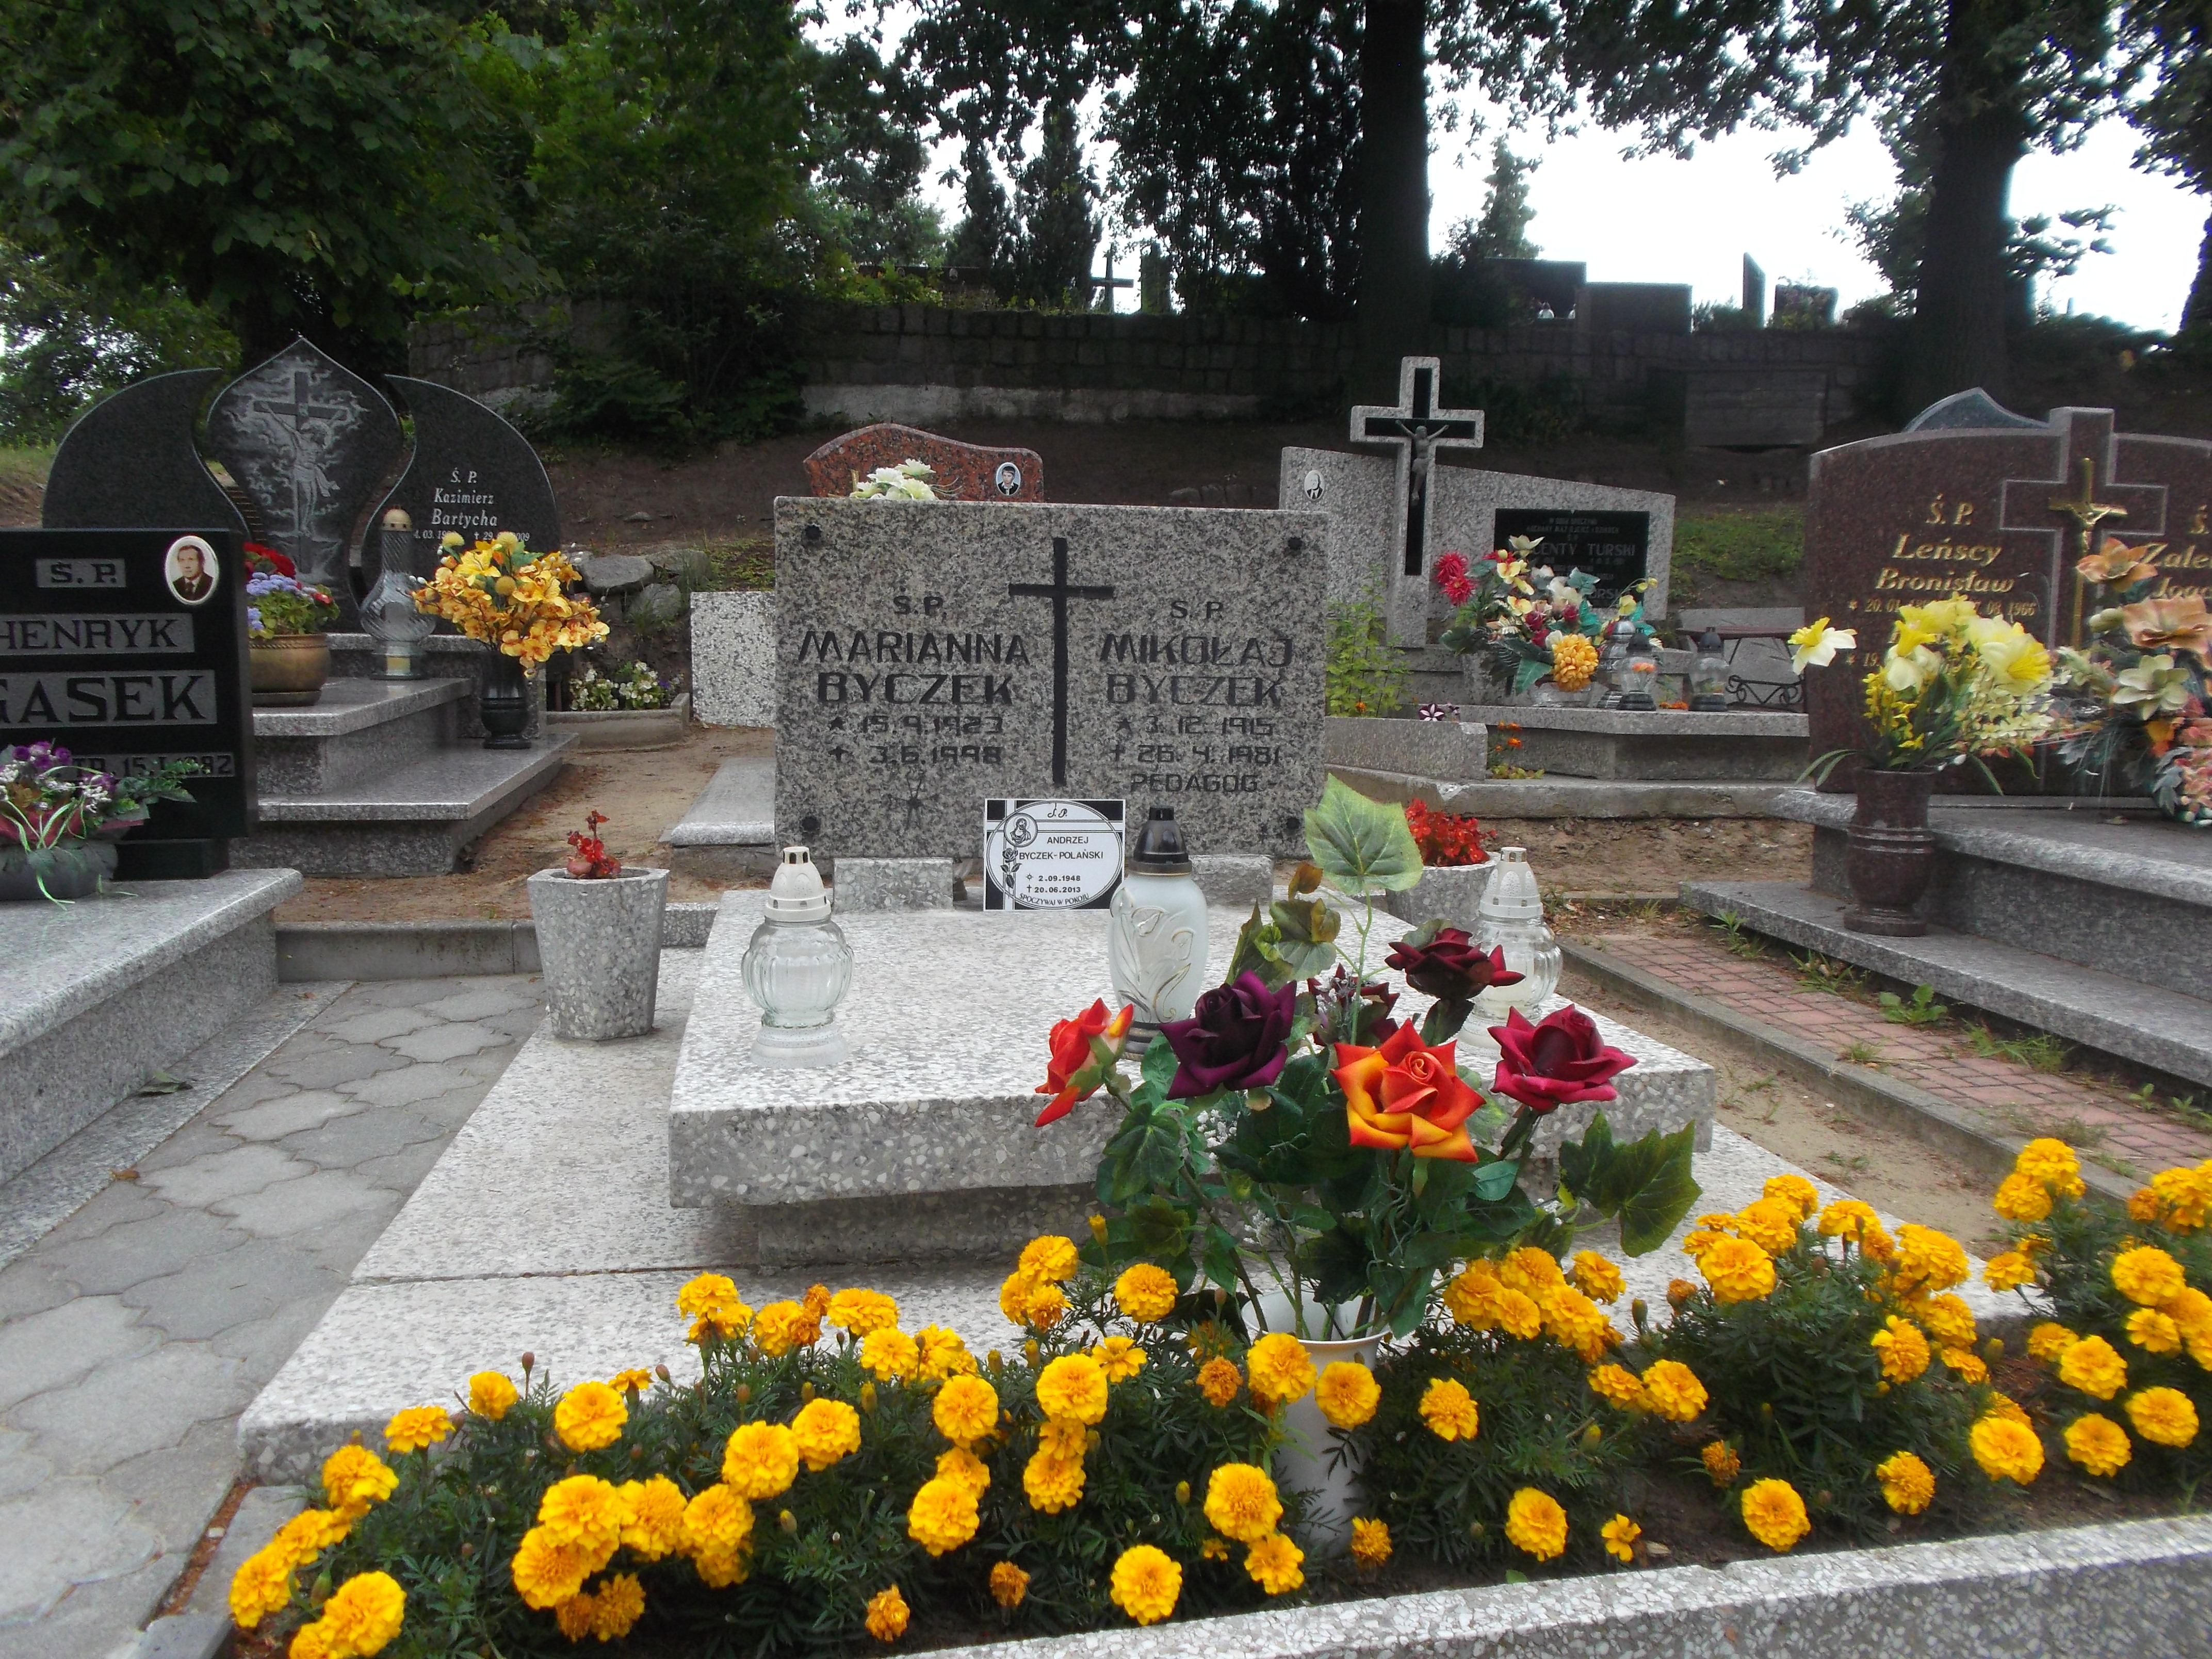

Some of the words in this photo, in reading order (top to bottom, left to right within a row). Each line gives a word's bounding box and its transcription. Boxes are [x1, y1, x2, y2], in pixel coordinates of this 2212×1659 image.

[467, 470, 478, 483] P.
[434, 488, 494, 505] Kazimierz
[431, 508, 498, 529] Bartycha
[1954, 502, 1975, 526] P.
[1892, 533, 2004, 567] Leńscy
[1875, 566, 2016, 593] Bronisław
[798, 630, 1030, 665] MARIANNA
[1099, 633, 1293, 668] MIKOŁAJ
[818, 672, 1013, 706] BYCZEK
[1107, 672, 1282, 707] BYCZEK
[1130, 773, 1260, 792] PEDAGOG
[1047, 836, 1089, 844] ANDRZEJ
